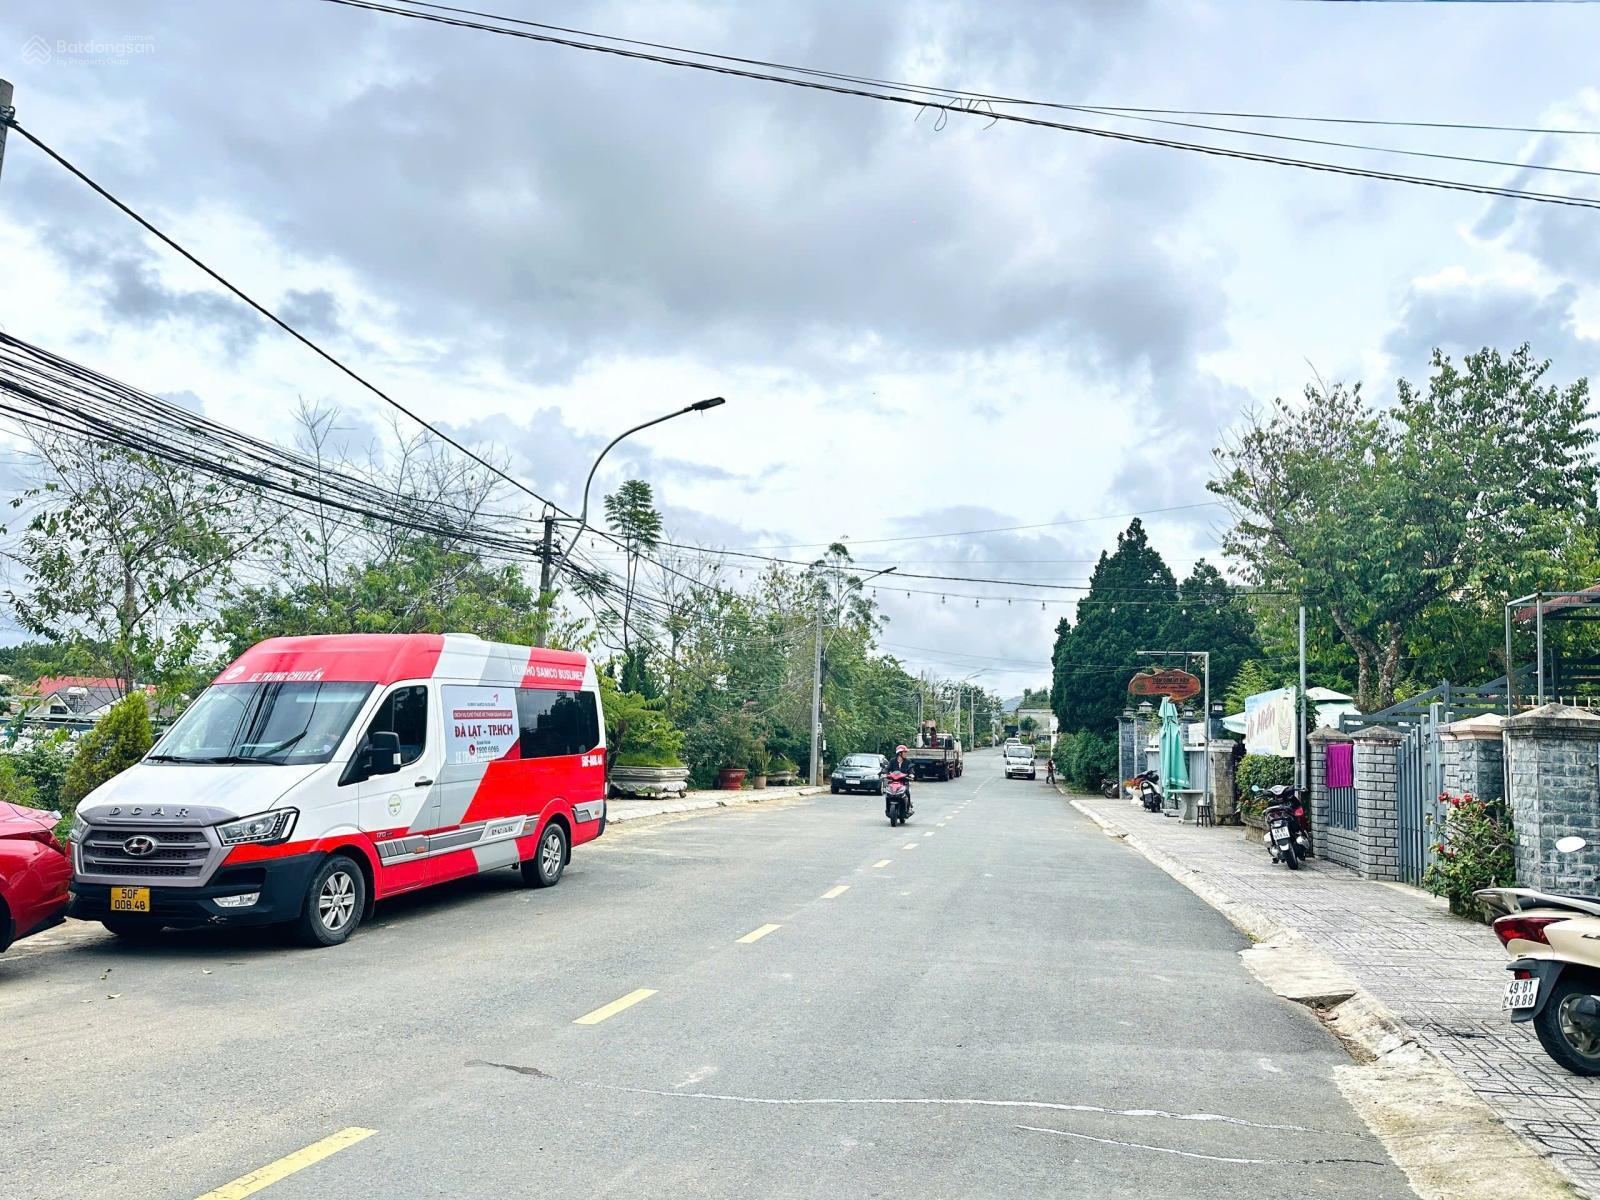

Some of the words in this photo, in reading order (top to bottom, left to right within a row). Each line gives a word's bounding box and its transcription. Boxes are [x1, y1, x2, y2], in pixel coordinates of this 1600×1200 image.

[259, 671, 287, 682] TRUNG
[536, 666, 558, 679] SAMCO
[557, 668, 584, 681] BUSLINES
[455, 723, 466, 737] ĐÀ
[468, 724, 482, 739] LẠT
[488, 724, 513, 736] TP.HCM
[121, 889, 139, 900] 50F
[114, 900, 146, 911] 008.48
